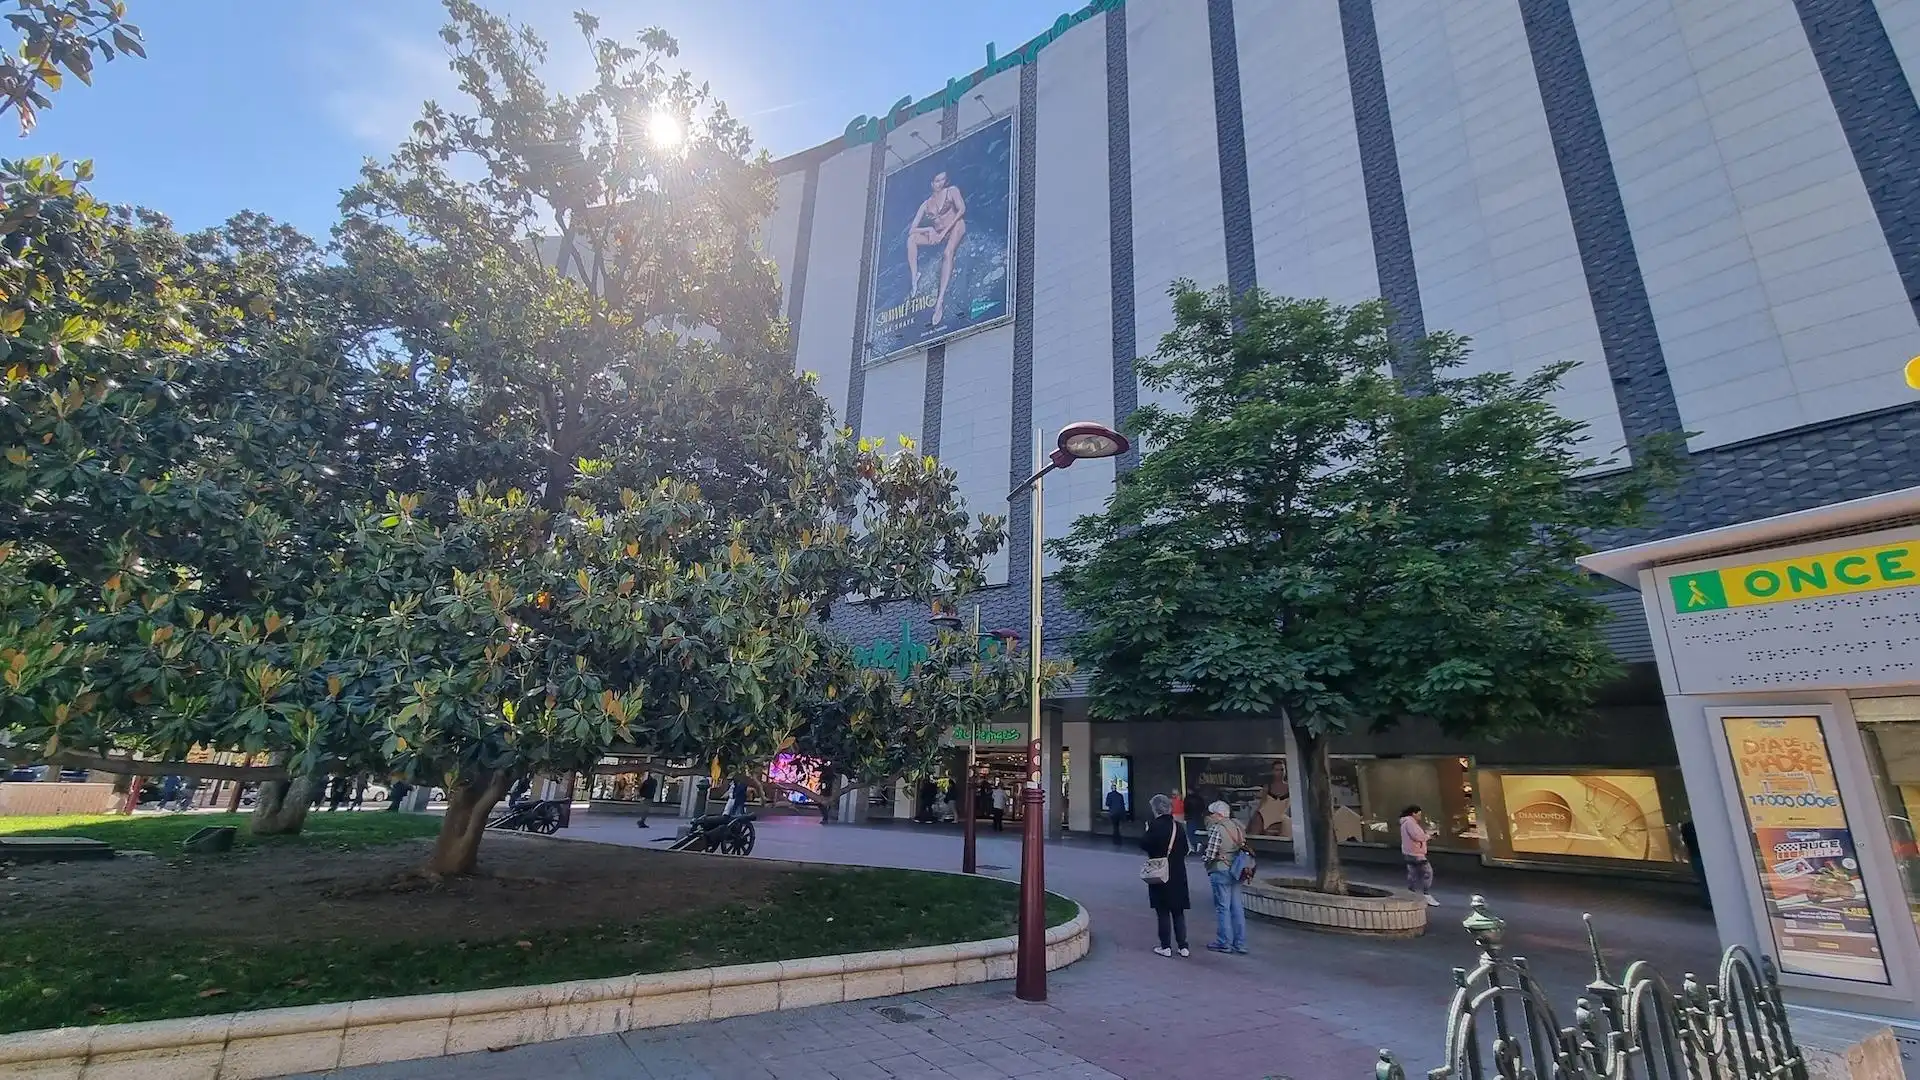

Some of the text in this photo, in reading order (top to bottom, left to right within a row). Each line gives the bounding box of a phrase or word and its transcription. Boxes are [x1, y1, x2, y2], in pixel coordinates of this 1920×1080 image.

[1744, 548, 1916, 597] ONCE
[1740, 748, 1825, 776] MADRE
[1748, 793, 1838, 809] 17.000.000€
[1519, 812, 1567, 820] DIAMONDS
[1799, 841, 1839, 850] RUGE
